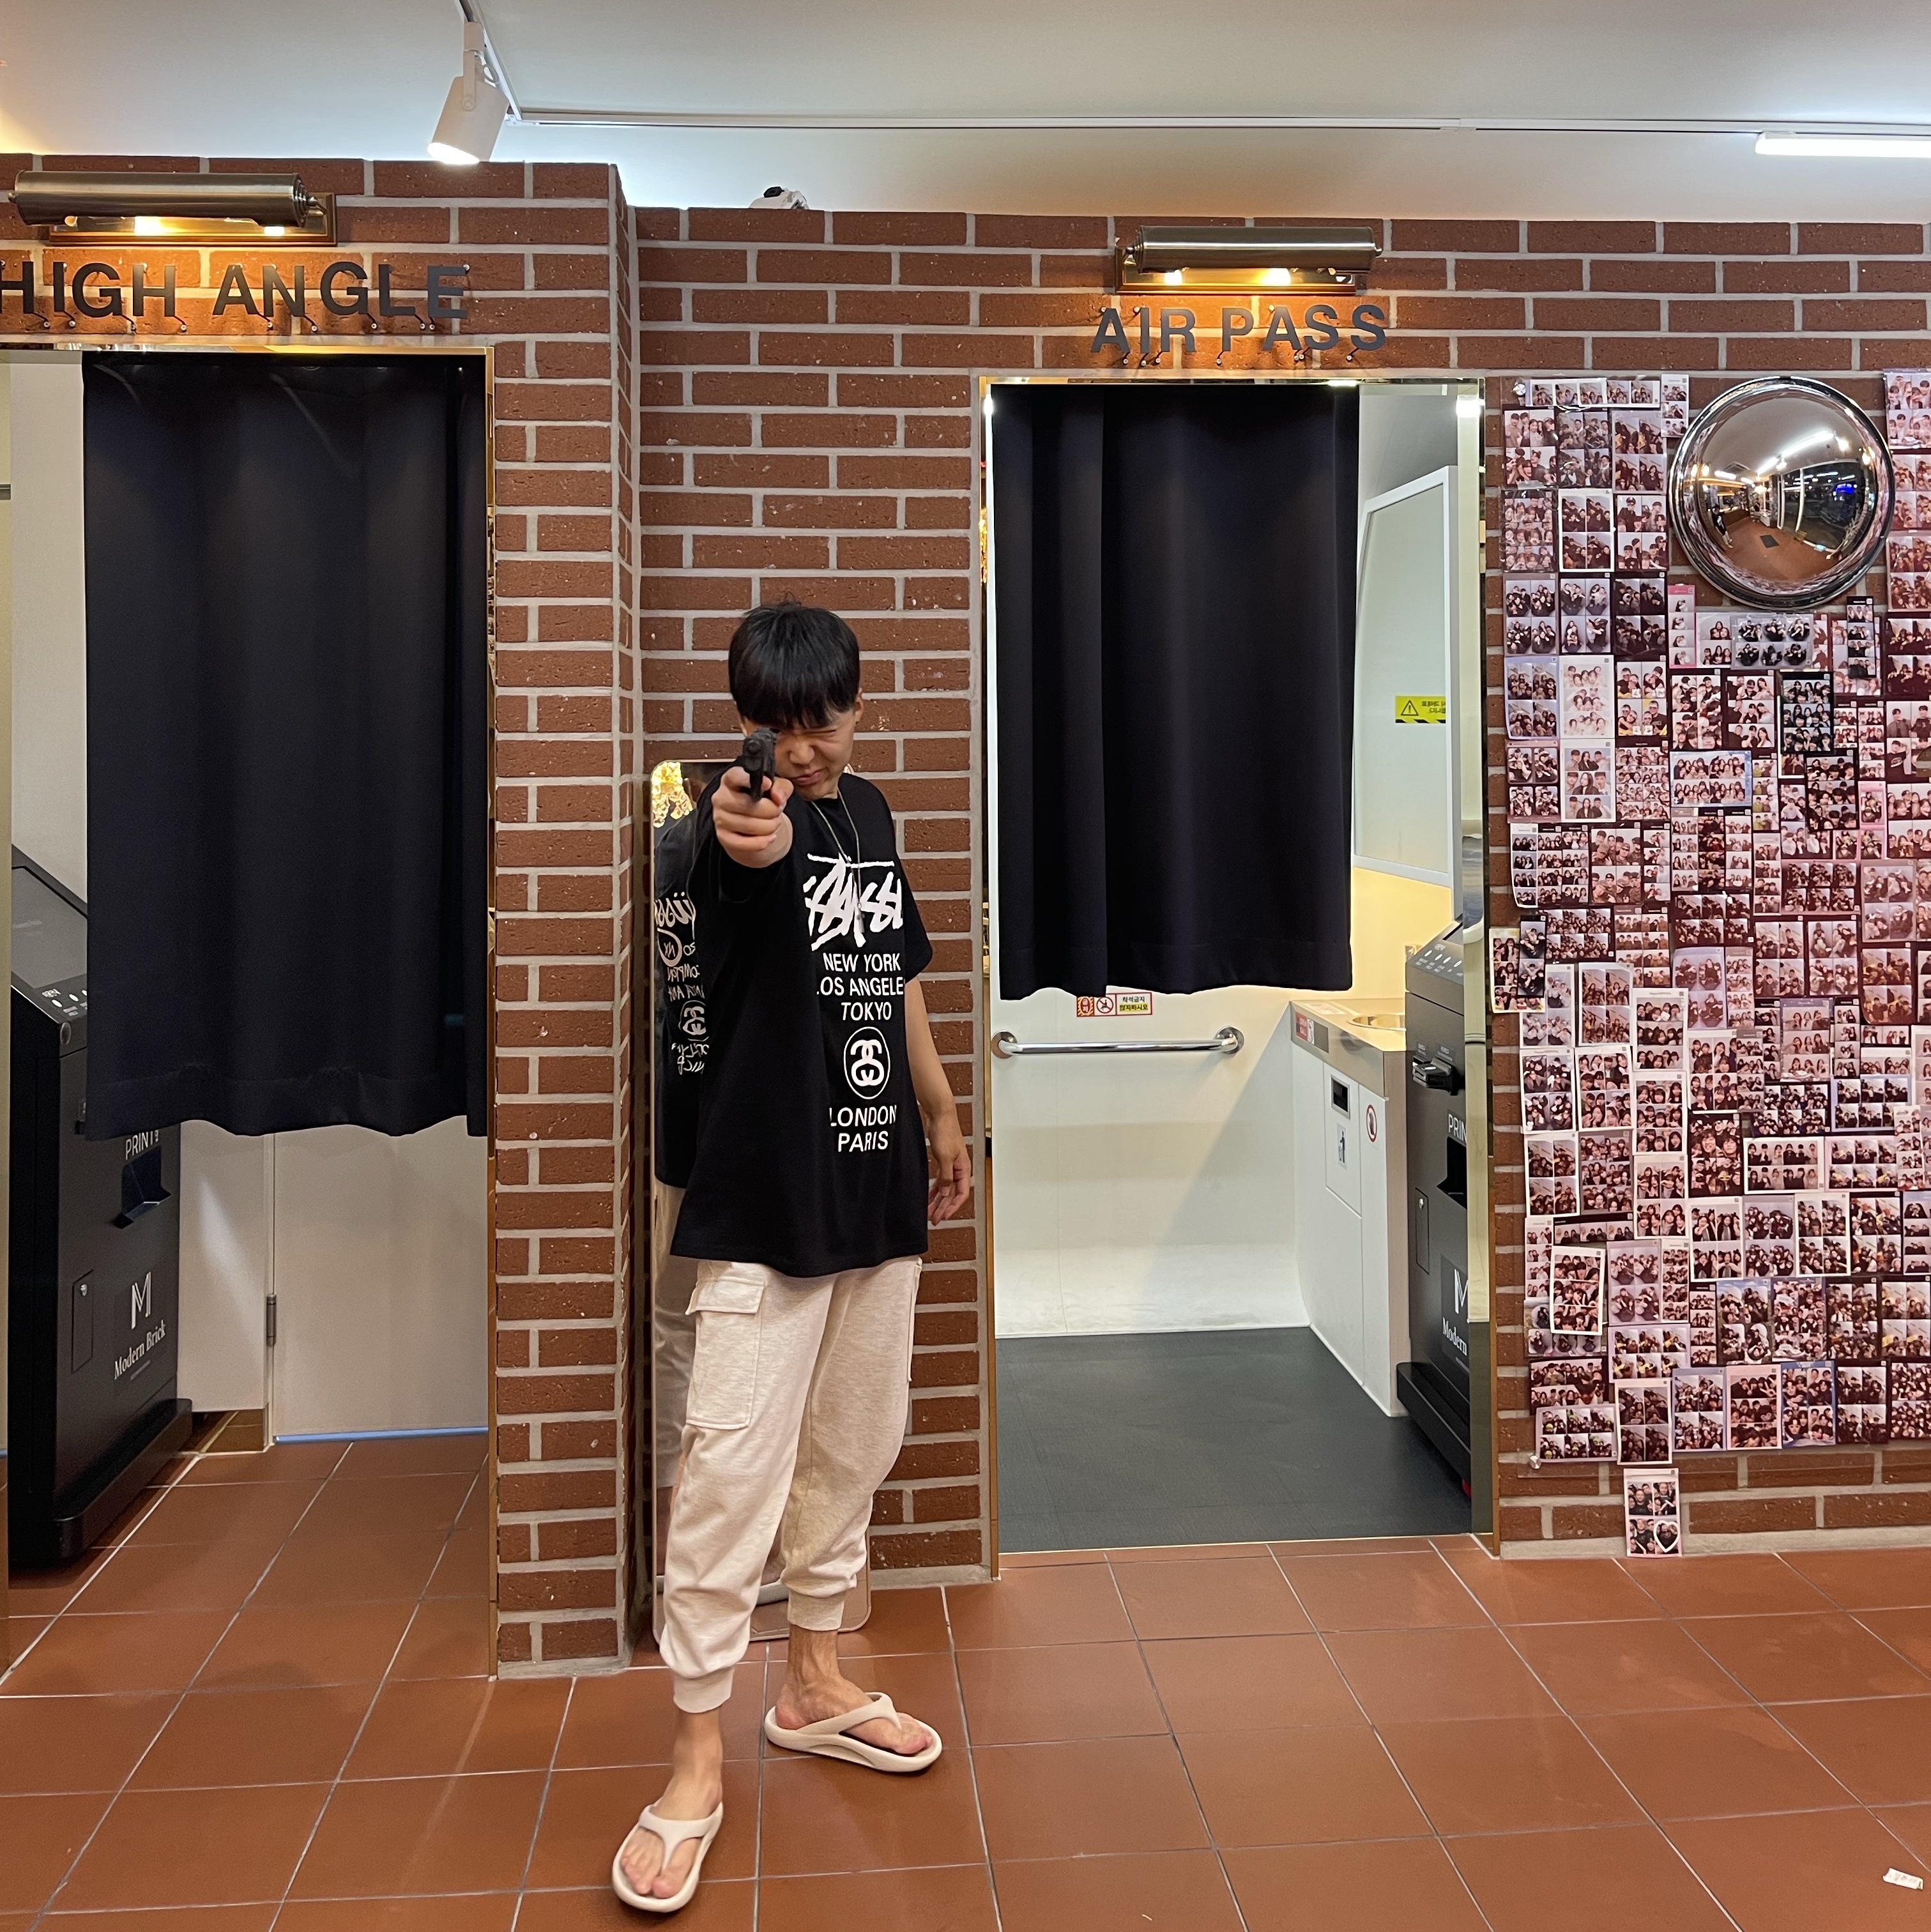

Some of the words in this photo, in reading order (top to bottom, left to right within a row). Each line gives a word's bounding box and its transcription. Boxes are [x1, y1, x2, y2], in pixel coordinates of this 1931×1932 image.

[0, 261, 176, 317] HIGH
[212, 261, 468, 319] ANGLE
[1090, 306, 1196, 353] AIR
[1222, 304, 1386, 351] PASS
[823, 952, 859, 972] NEW
[864, 953, 901, 972] YORK
[816, 977, 844, 996] OS
[850, 977, 906, 996] ANGELE
[841, 1001, 892, 1021] TOKYO
[829, 1104, 897, 1127] LONDON
[1448, 1113, 1467, 1144] PRIN
[837, 1130, 889, 1152] PARIS
[114, 1343, 145, 1380] Modern
[146, 1319, 166, 1351] Brick
[1442, 1316, 1467, 1356] Modern
